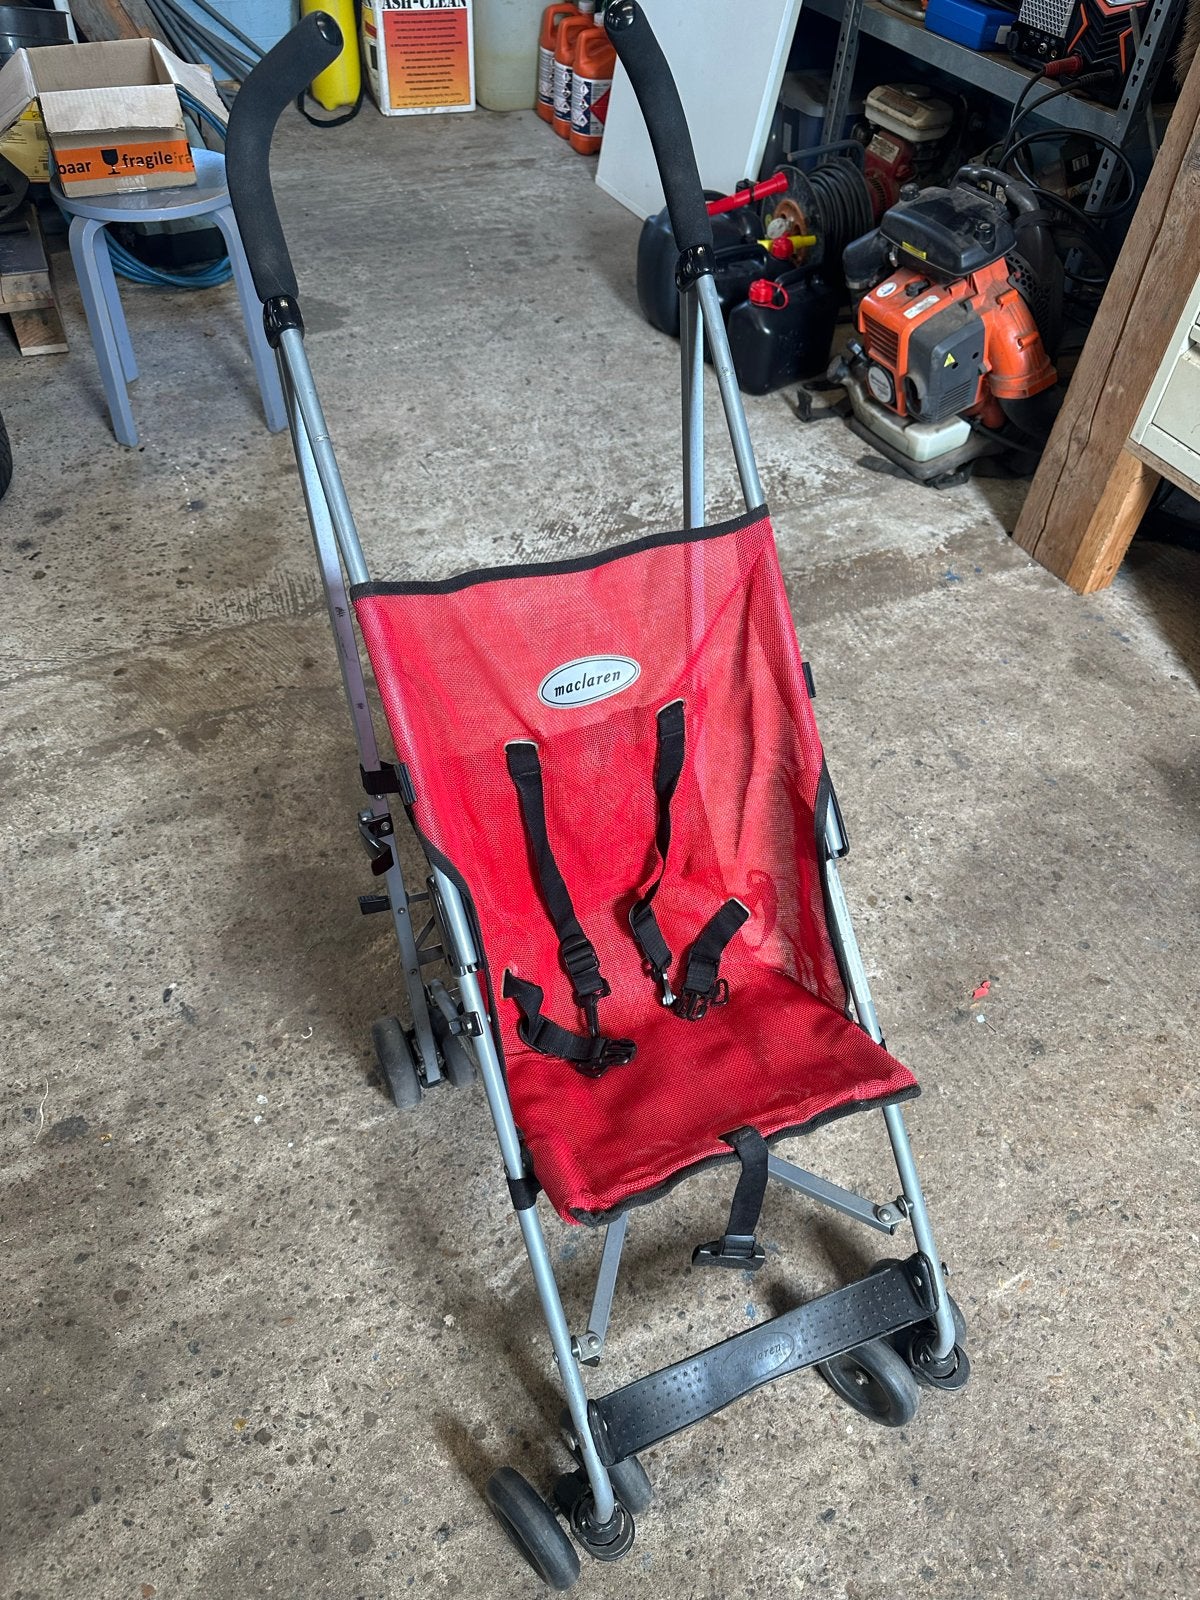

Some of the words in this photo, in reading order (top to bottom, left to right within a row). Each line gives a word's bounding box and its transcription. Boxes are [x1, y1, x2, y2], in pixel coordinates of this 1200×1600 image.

[382, 0, 467, 10] ASH-CLEAN
[122, 151, 173, 169] fragile
[554, 671, 621, 697] maclaren
